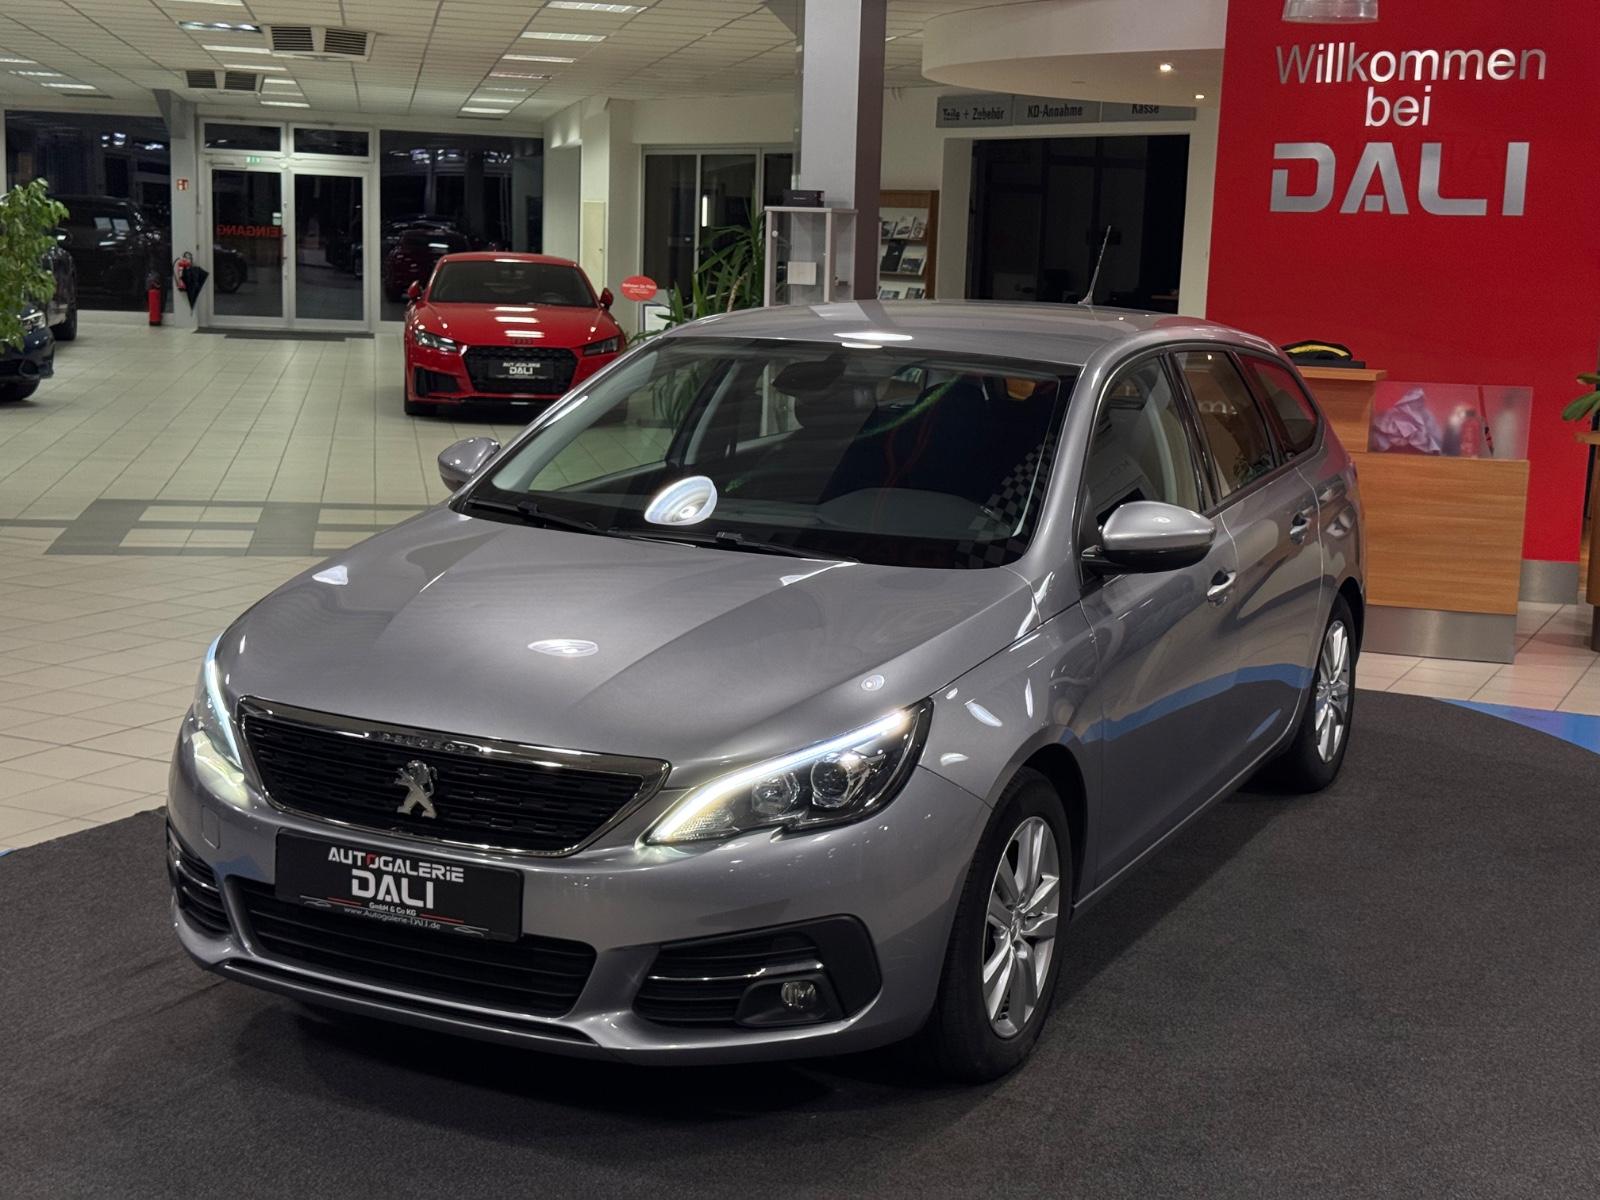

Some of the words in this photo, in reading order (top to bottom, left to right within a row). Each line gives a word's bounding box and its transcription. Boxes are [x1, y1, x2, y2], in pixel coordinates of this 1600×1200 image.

[1276, 42, 1547, 84] Willkommen
[972, 107, 1005, 120] Zubehör
[1027, 104, 1083, 118] KD-Annahme
[1131, 104, 1160, 114] Kasse
[1365, 85, 1432, 127] bei
[1270, 141, 1530, 216] DALI
[509, 366, 533, 375] DALI
[328, 847, 465, 883] AUTOGALERIE
[352, 868, 435, 909] DALI
[369, 902, 389, 911] GmbH
[406, 908, 417, 917] KG
